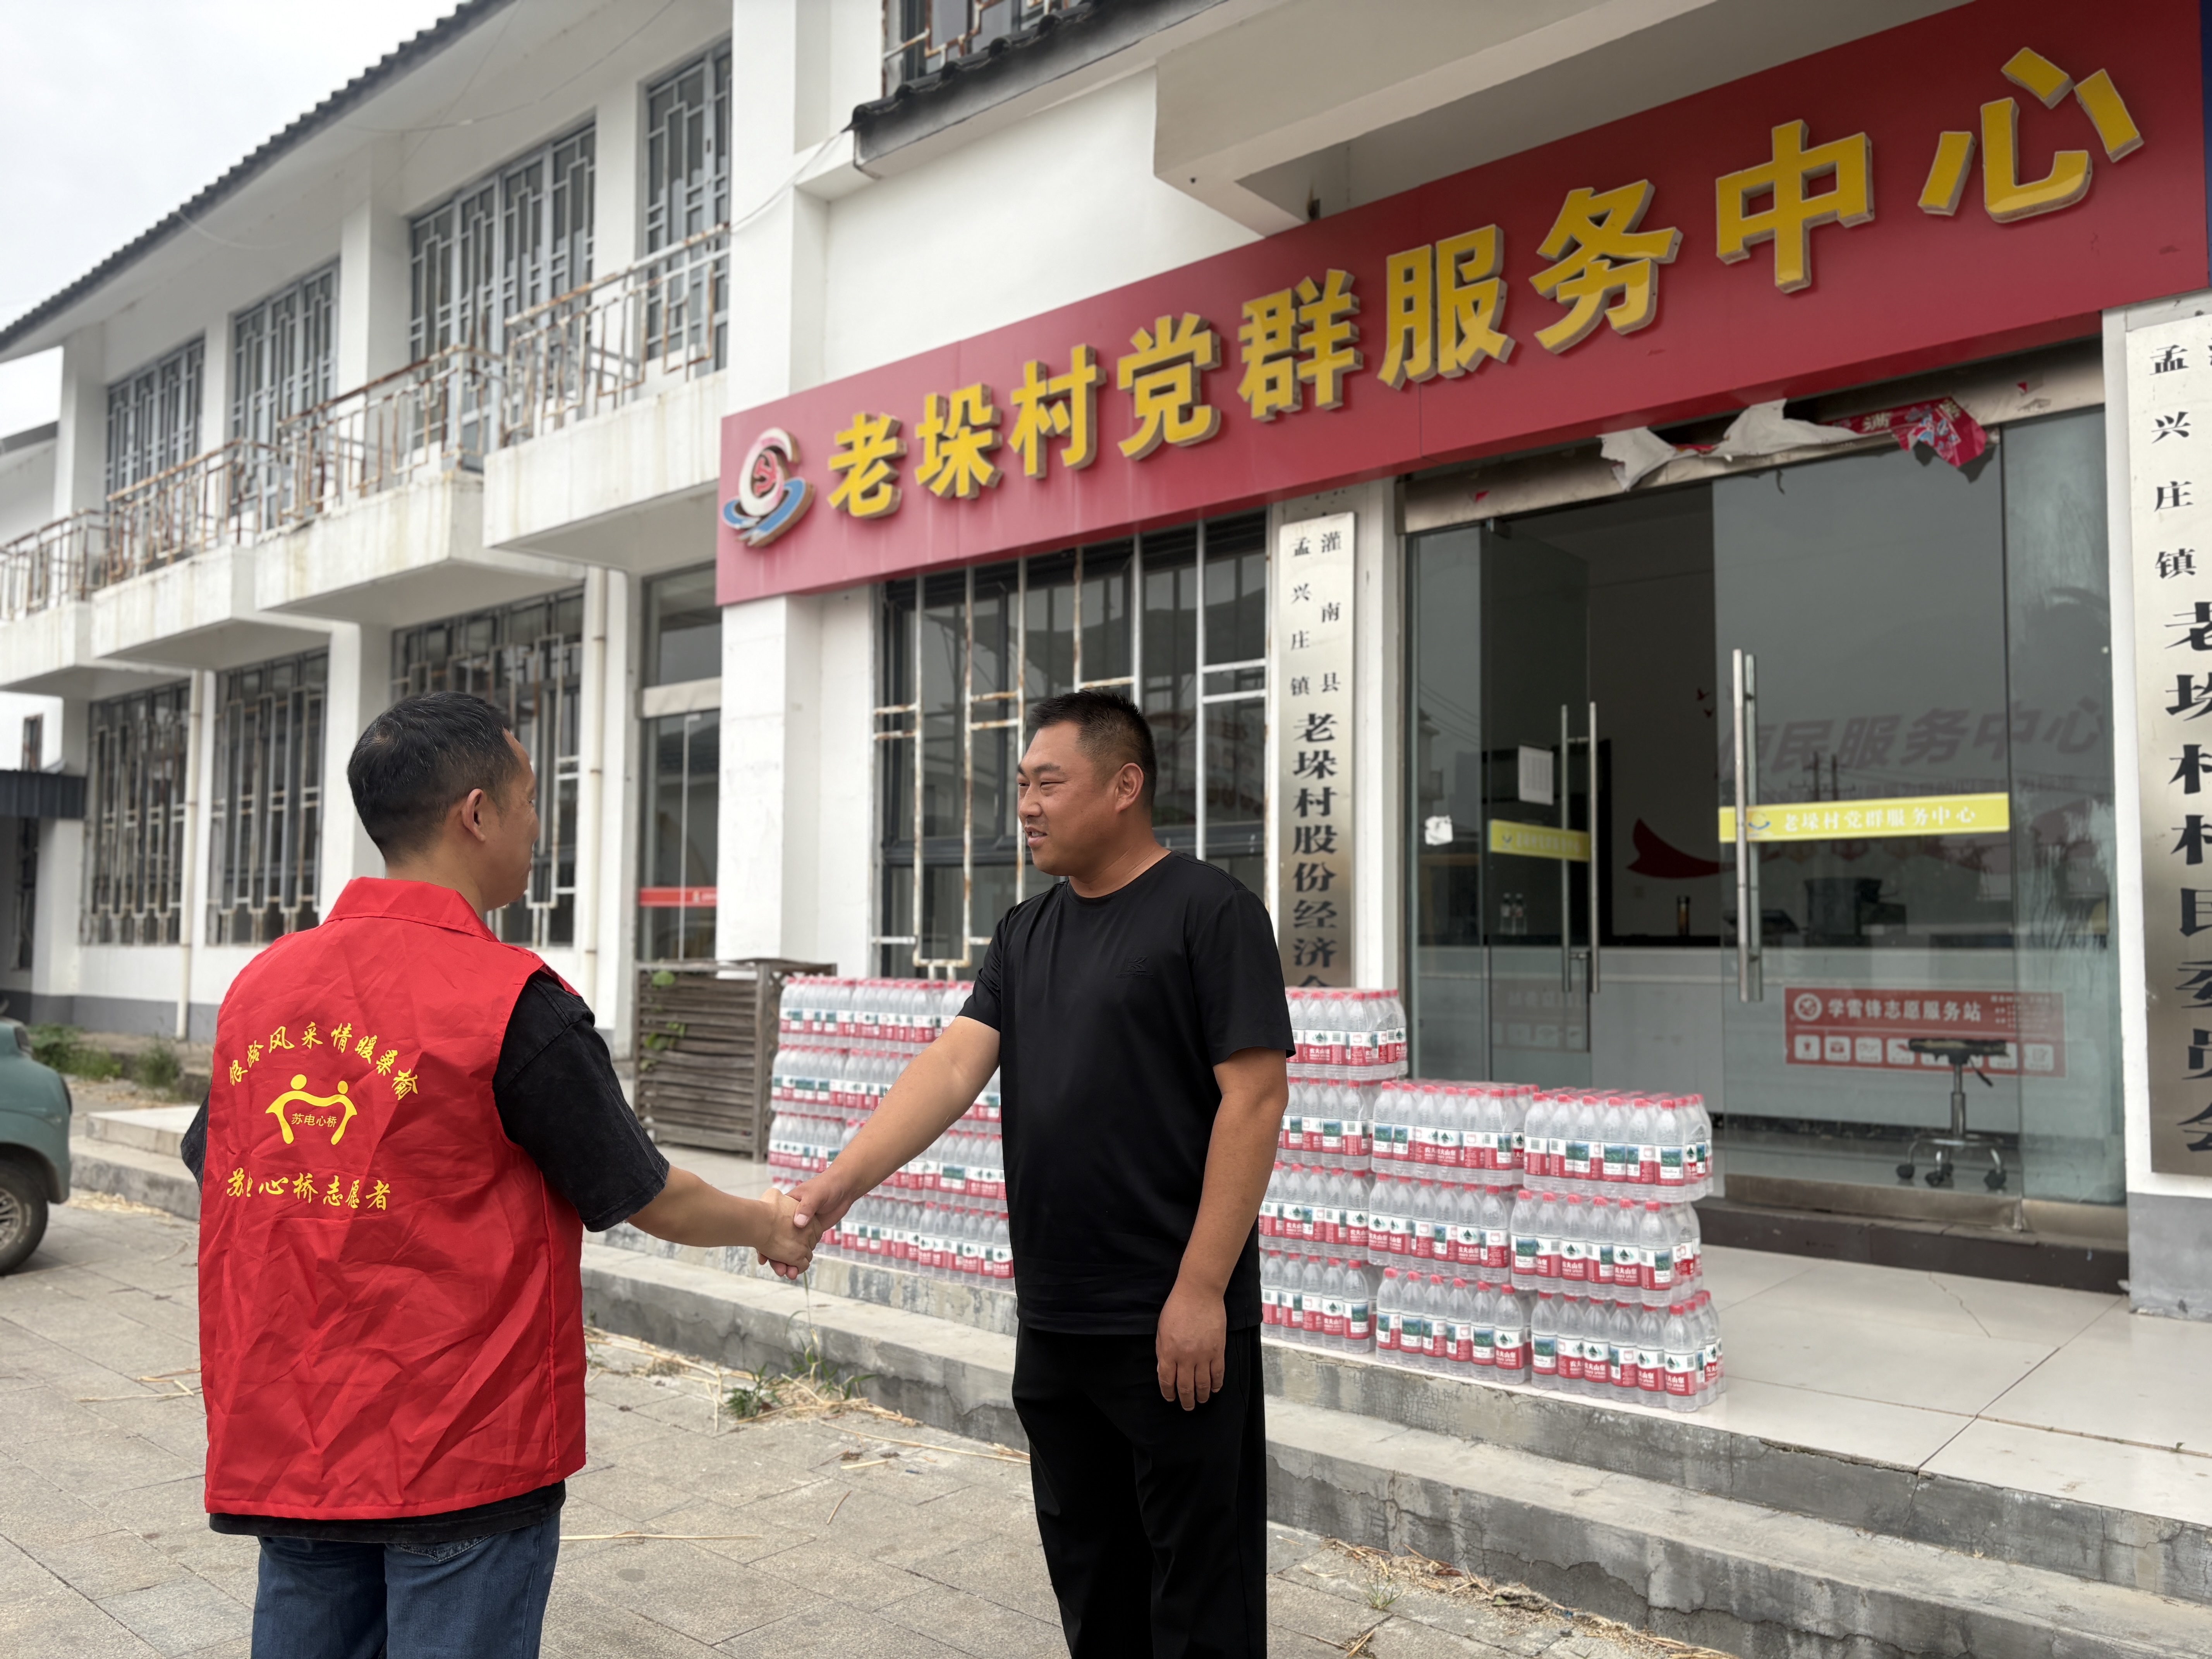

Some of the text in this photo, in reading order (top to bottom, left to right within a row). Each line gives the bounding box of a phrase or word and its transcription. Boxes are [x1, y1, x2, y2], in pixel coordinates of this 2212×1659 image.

[827, 46, 2143, 521] 老垛村党群服务中心
[2150, 344, 2197, 580] 孟兴庄镇
[1290, 537, 1312, 696] 孟兴庄镇
[1320, 531, 1342, 692] 灌南县
[1784, 806, 1976, 831] 老垛村党群服务中心
[1828, 998, 1982, 1022] 学雷锋志愿服务站
[291, 1113, 337, 1128] 苏电心桥
